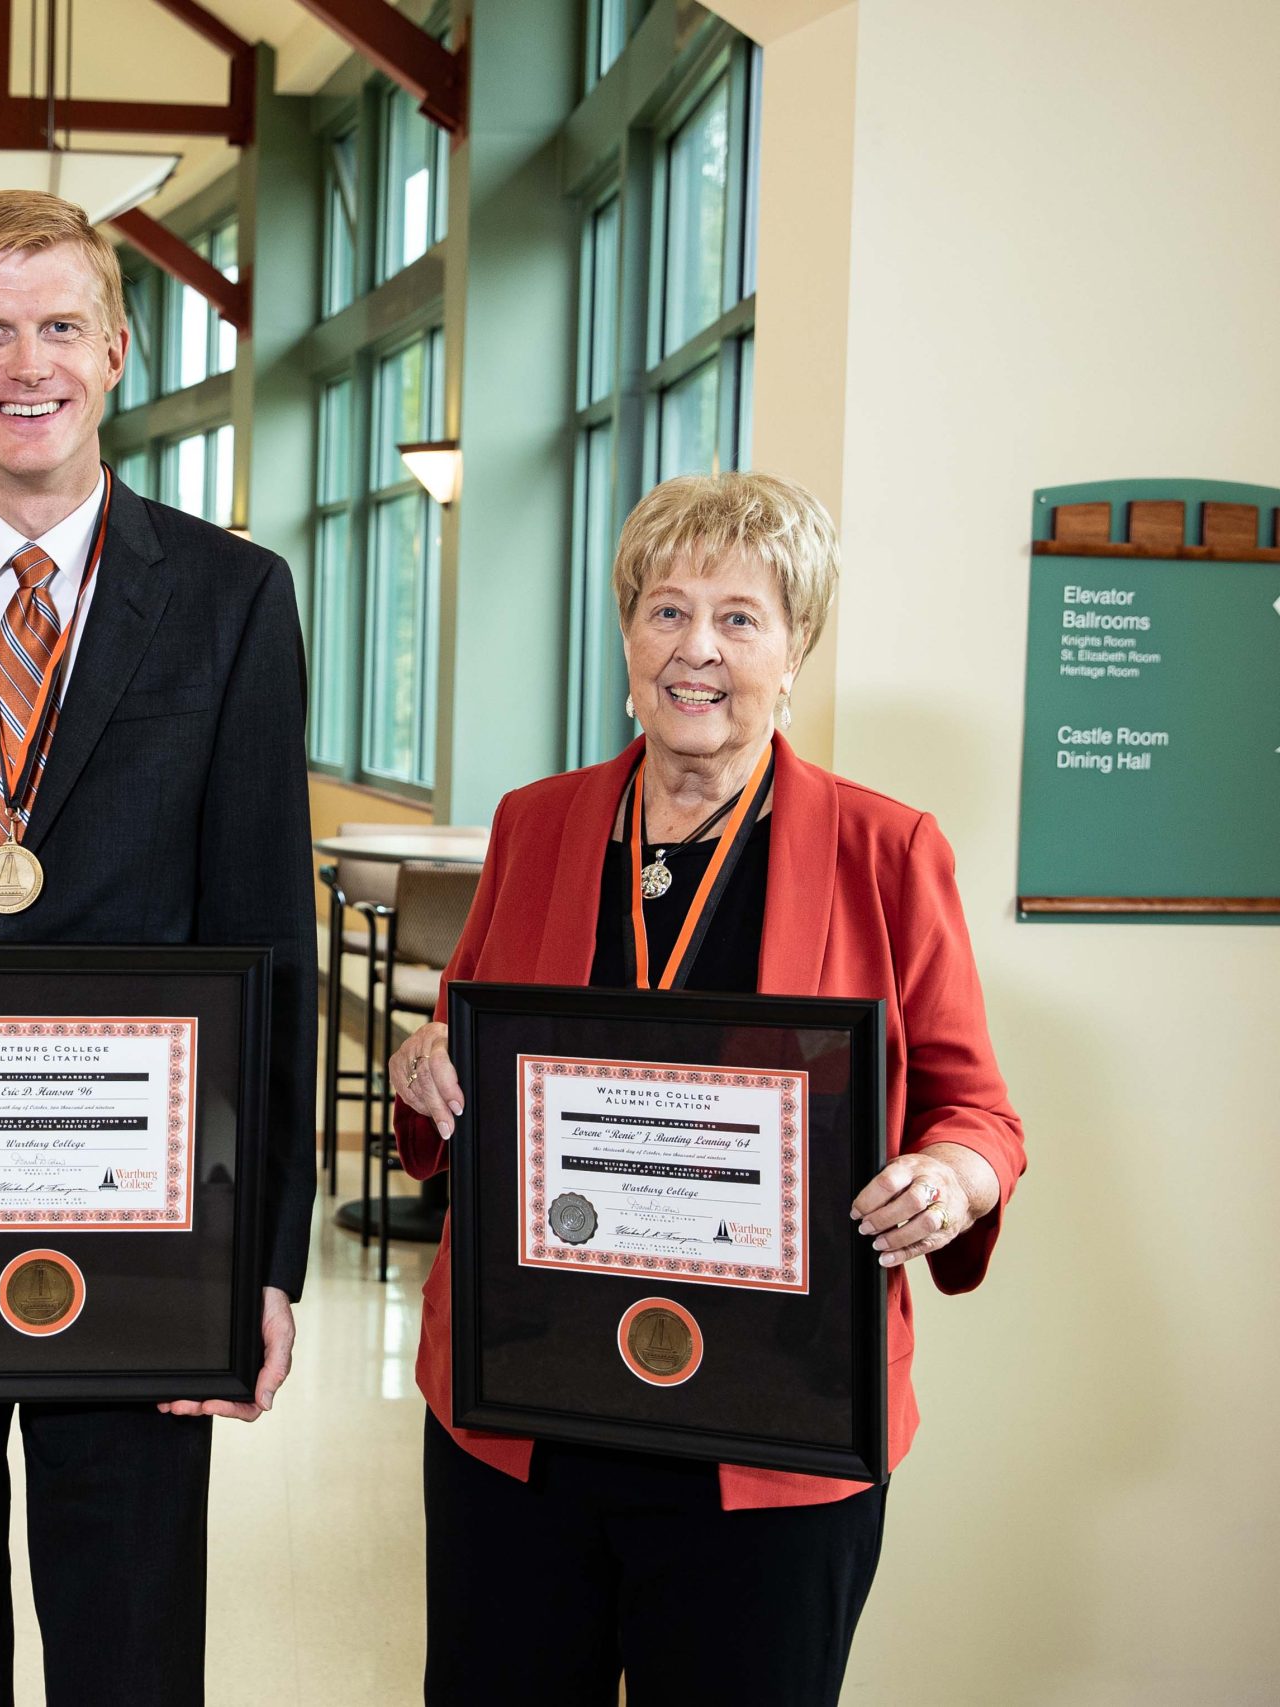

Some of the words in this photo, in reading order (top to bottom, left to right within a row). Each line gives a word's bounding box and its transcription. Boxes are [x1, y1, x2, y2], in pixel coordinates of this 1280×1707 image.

[1063, 585, 1136, 605] Elevator
[1062, 609, 1151, 631] Ballrooms
[1061, 634, 1102, 649] Knights
[1103, 635, 1137, 647] Room
[1077, 649, 1127, 662] Elizabeth
[1128, 650, 1161, 663] Room
[1060, 663, 1106, 679] Heritage
[1106, 664, 1140, 677] Room
[1057, 725, 1113, 745] Castle
[1116, 727, 1169, 746] Room
[1056, 750, 1113, 773] Dining
[1116, 752, 1152, 770] Hall
[54, 1045, 109, 1053] COLLEGE
[43, 1054, 100, 1062] CITATION
[1, 1086, 19, 1096] Eric
[35, 1086, 74, 1096] Hanson
[77, 1086, 93, 1096] '96
[596, 1087, 660, 1098] WARTBURG
[666, 1091, 720, 1102] COLLEGE
[605, 1097, 649, 1106] ALUMNI
[655, 1100, 711, 1110] CITATION
[6, 1139, 50, 1150] Wartburg
[52, 1139, 86, 1149] College
[571, 1126, 602, 1138] Lorene
[653, 1132, 692, 1147] Bunting
[694, 1135, 731, 1149] Lenning
[735, 1138, 751, 1148] '64
[115, 1168, 158, 1180] Wartburg
[674, 1167, 731, 1175] PARTICIPATION
[120, 1179, 153, 1191] College
[621, 1182, 663, 1197] Wartburg
[666, 1186, 699, 1199] College
[729, 1221, 772, 1237] Wartburg
[734, 1234, 768, 1247] College
